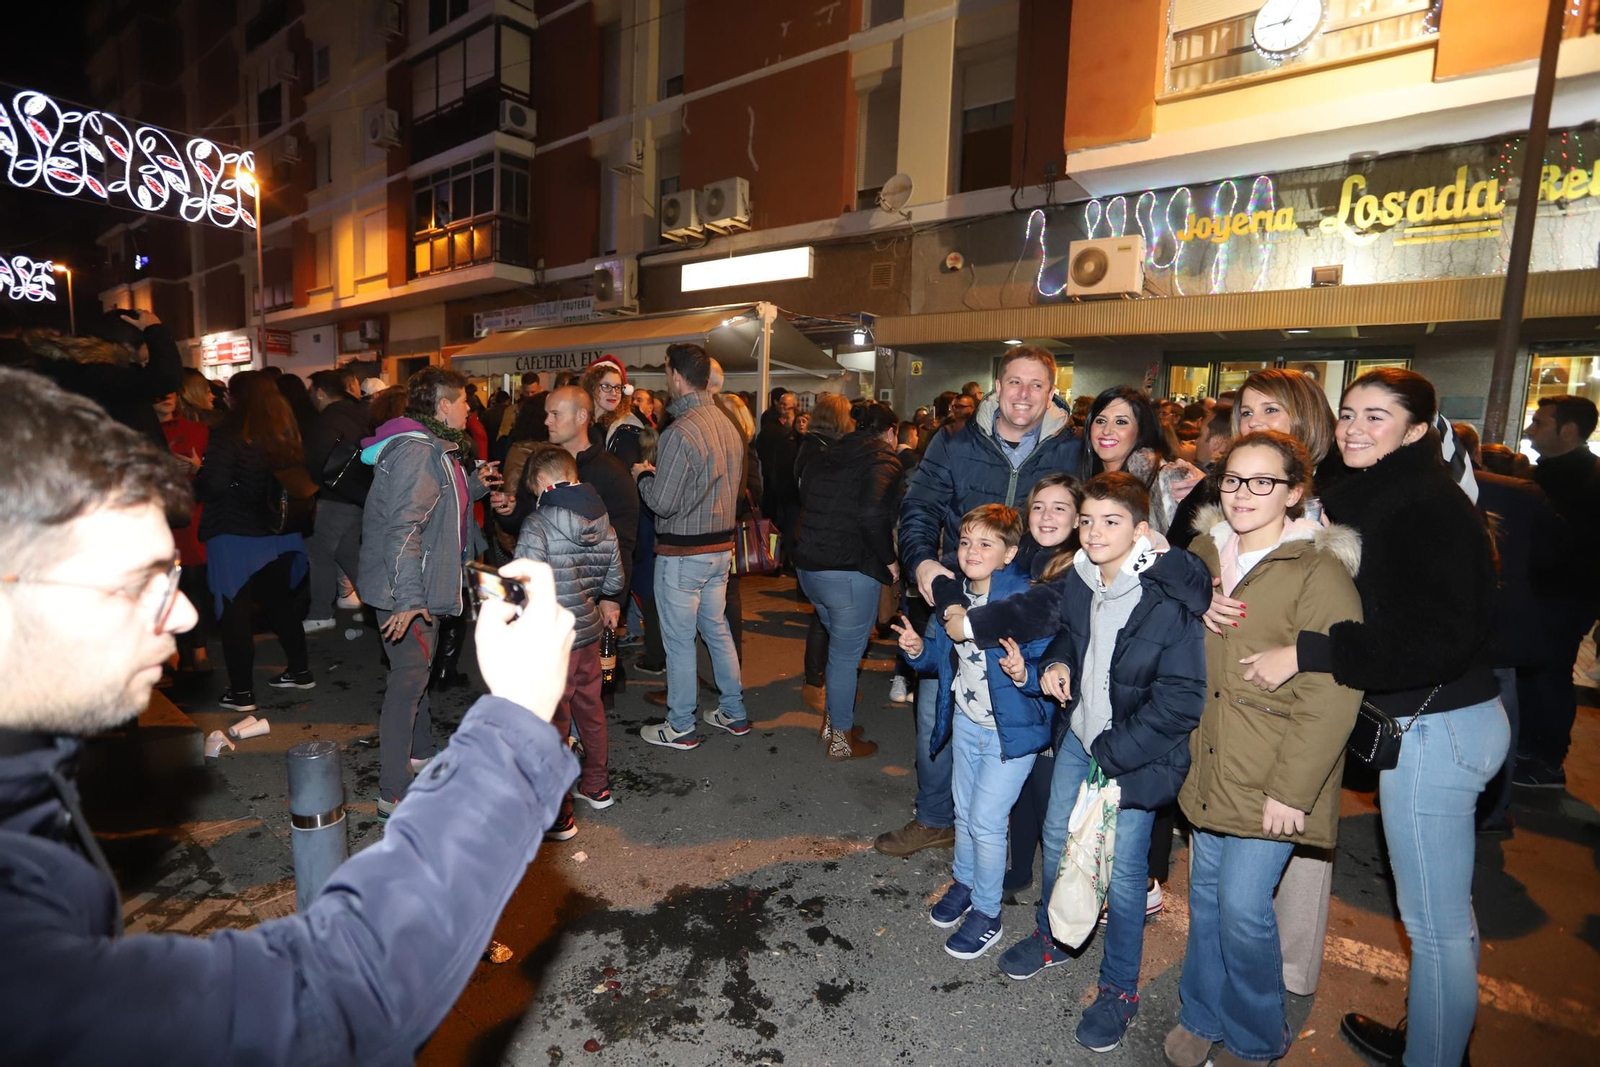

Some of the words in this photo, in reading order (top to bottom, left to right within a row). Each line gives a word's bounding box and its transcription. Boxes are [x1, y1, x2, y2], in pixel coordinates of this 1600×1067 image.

[1319, 165, 1506, 247] Losada
[563, 299, 591, 311] FRUTERIA
[516, 353, 577, 371] CAFETERIA
